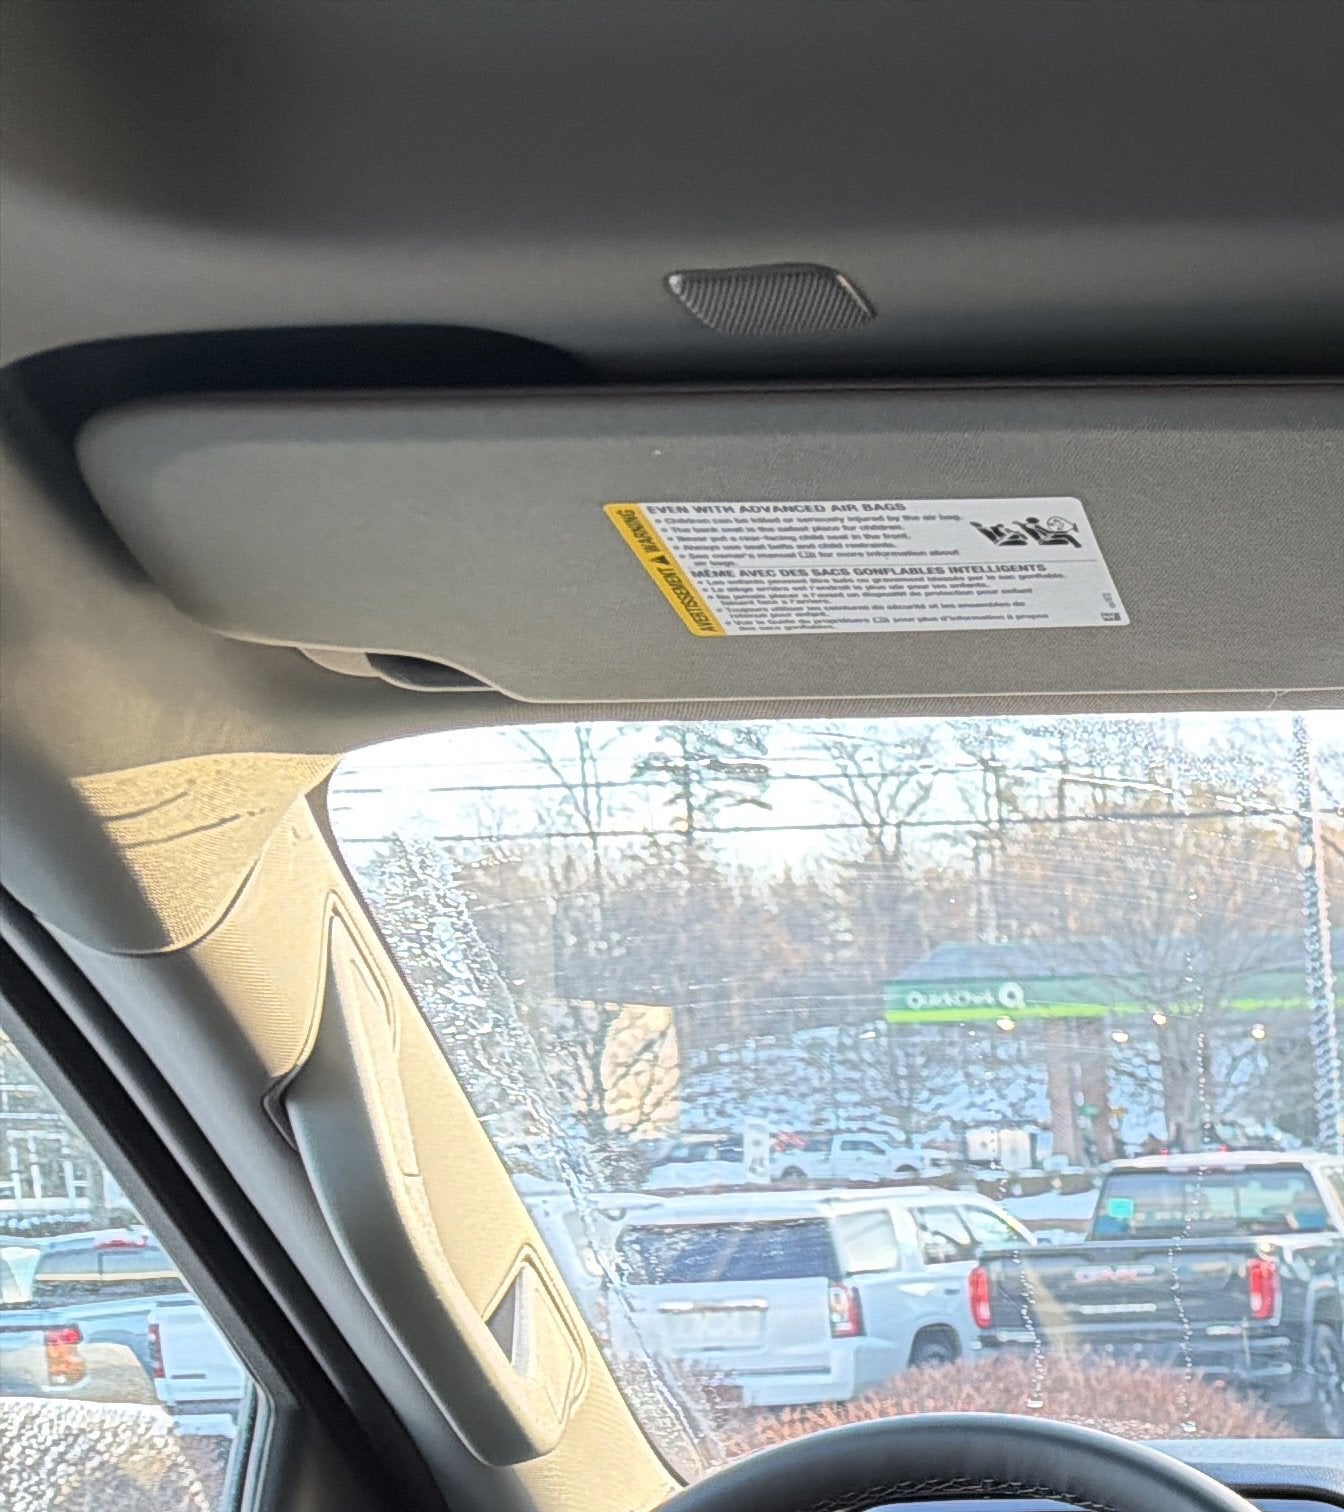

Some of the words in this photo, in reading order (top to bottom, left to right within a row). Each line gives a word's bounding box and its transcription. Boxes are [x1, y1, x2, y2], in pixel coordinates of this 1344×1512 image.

[647, 505, 689, 514] EVEN
[693, 505, 736, 514] WITH
[738, 504, 826, 513] ADVANCED
[832, 504, 858, 512] AIR
[862, 503, 906, 512] BAGS
[739, 569, 778, 578] AVEC
[781, 569, 809, 577] DES
[813, 568, 850, 576] SACS
[949, 564, 1047, 574] INTELLIGENTS
